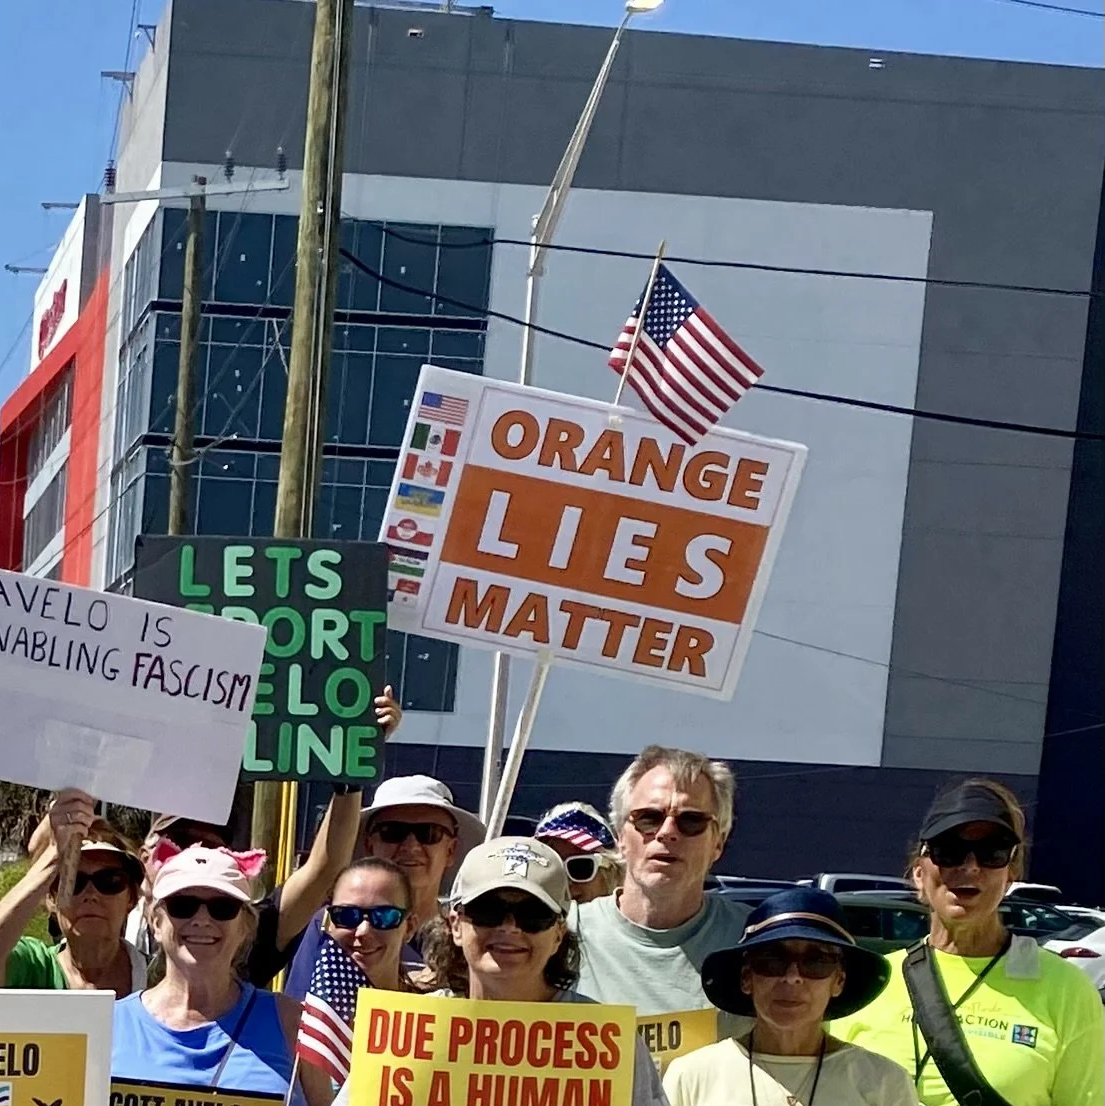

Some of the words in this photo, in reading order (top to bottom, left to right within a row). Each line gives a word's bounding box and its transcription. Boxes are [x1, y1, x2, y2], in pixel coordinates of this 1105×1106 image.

[491, 410, 770, 510] ORANGE
[180, 545, 342, 600] LETS
[477, 490, 734, 600] LIES
[141, 612, 173, 648] IS
[446, 577, 715, 678] MATTER
[131, 652, 252, 712] FASCISM
[253, 664, 372, 718] ELO
[244, 720, 377, 778] LINE
[366, 1008, 436, 1060] DUE
[448, 1016, 622, 1070] PROCESS
[637, 1020, 682, 1053] ELO
